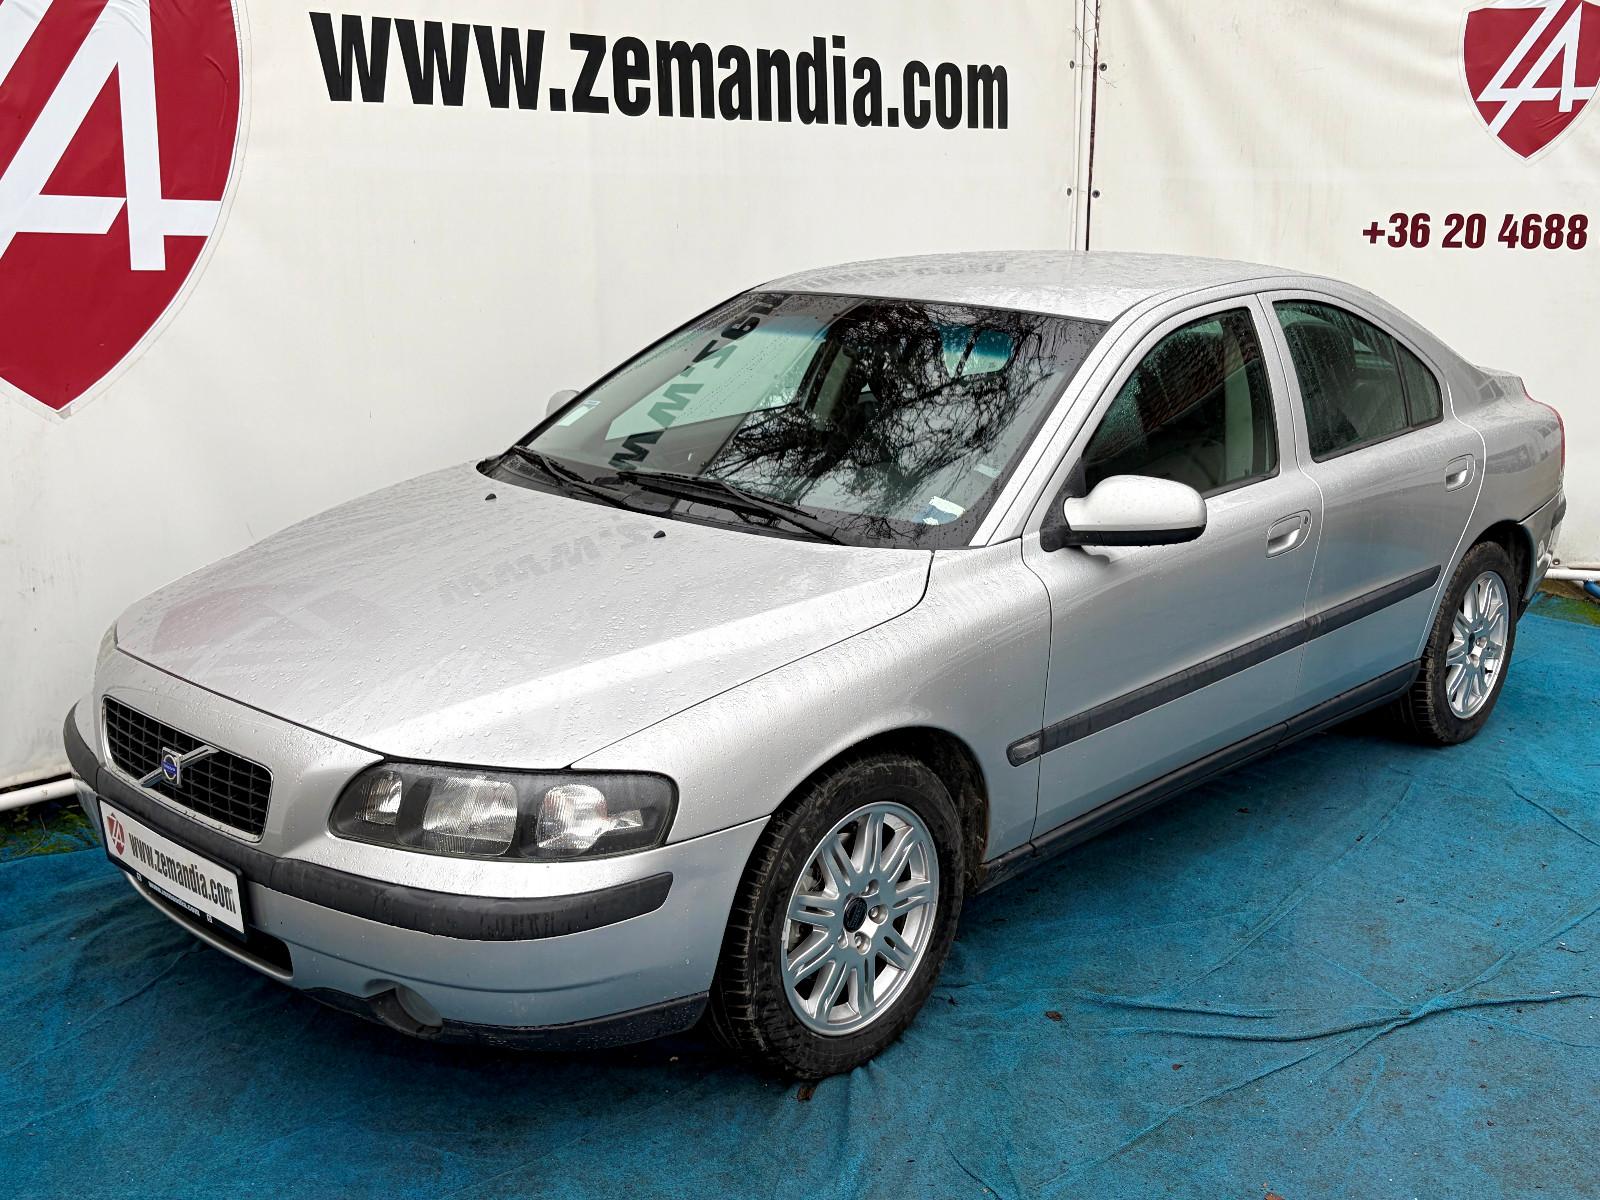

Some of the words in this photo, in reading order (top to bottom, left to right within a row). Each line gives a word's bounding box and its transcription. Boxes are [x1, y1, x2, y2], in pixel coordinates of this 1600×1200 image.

[309, 12, 1007, 129] www.zemandia.com
[1362, 212, 1431, 248] +36
[1441, 213, 1487, 249] 20
[1497, 213, 1588, 250] 4688
[129, 833, 237, 914] www.zemandia.com
